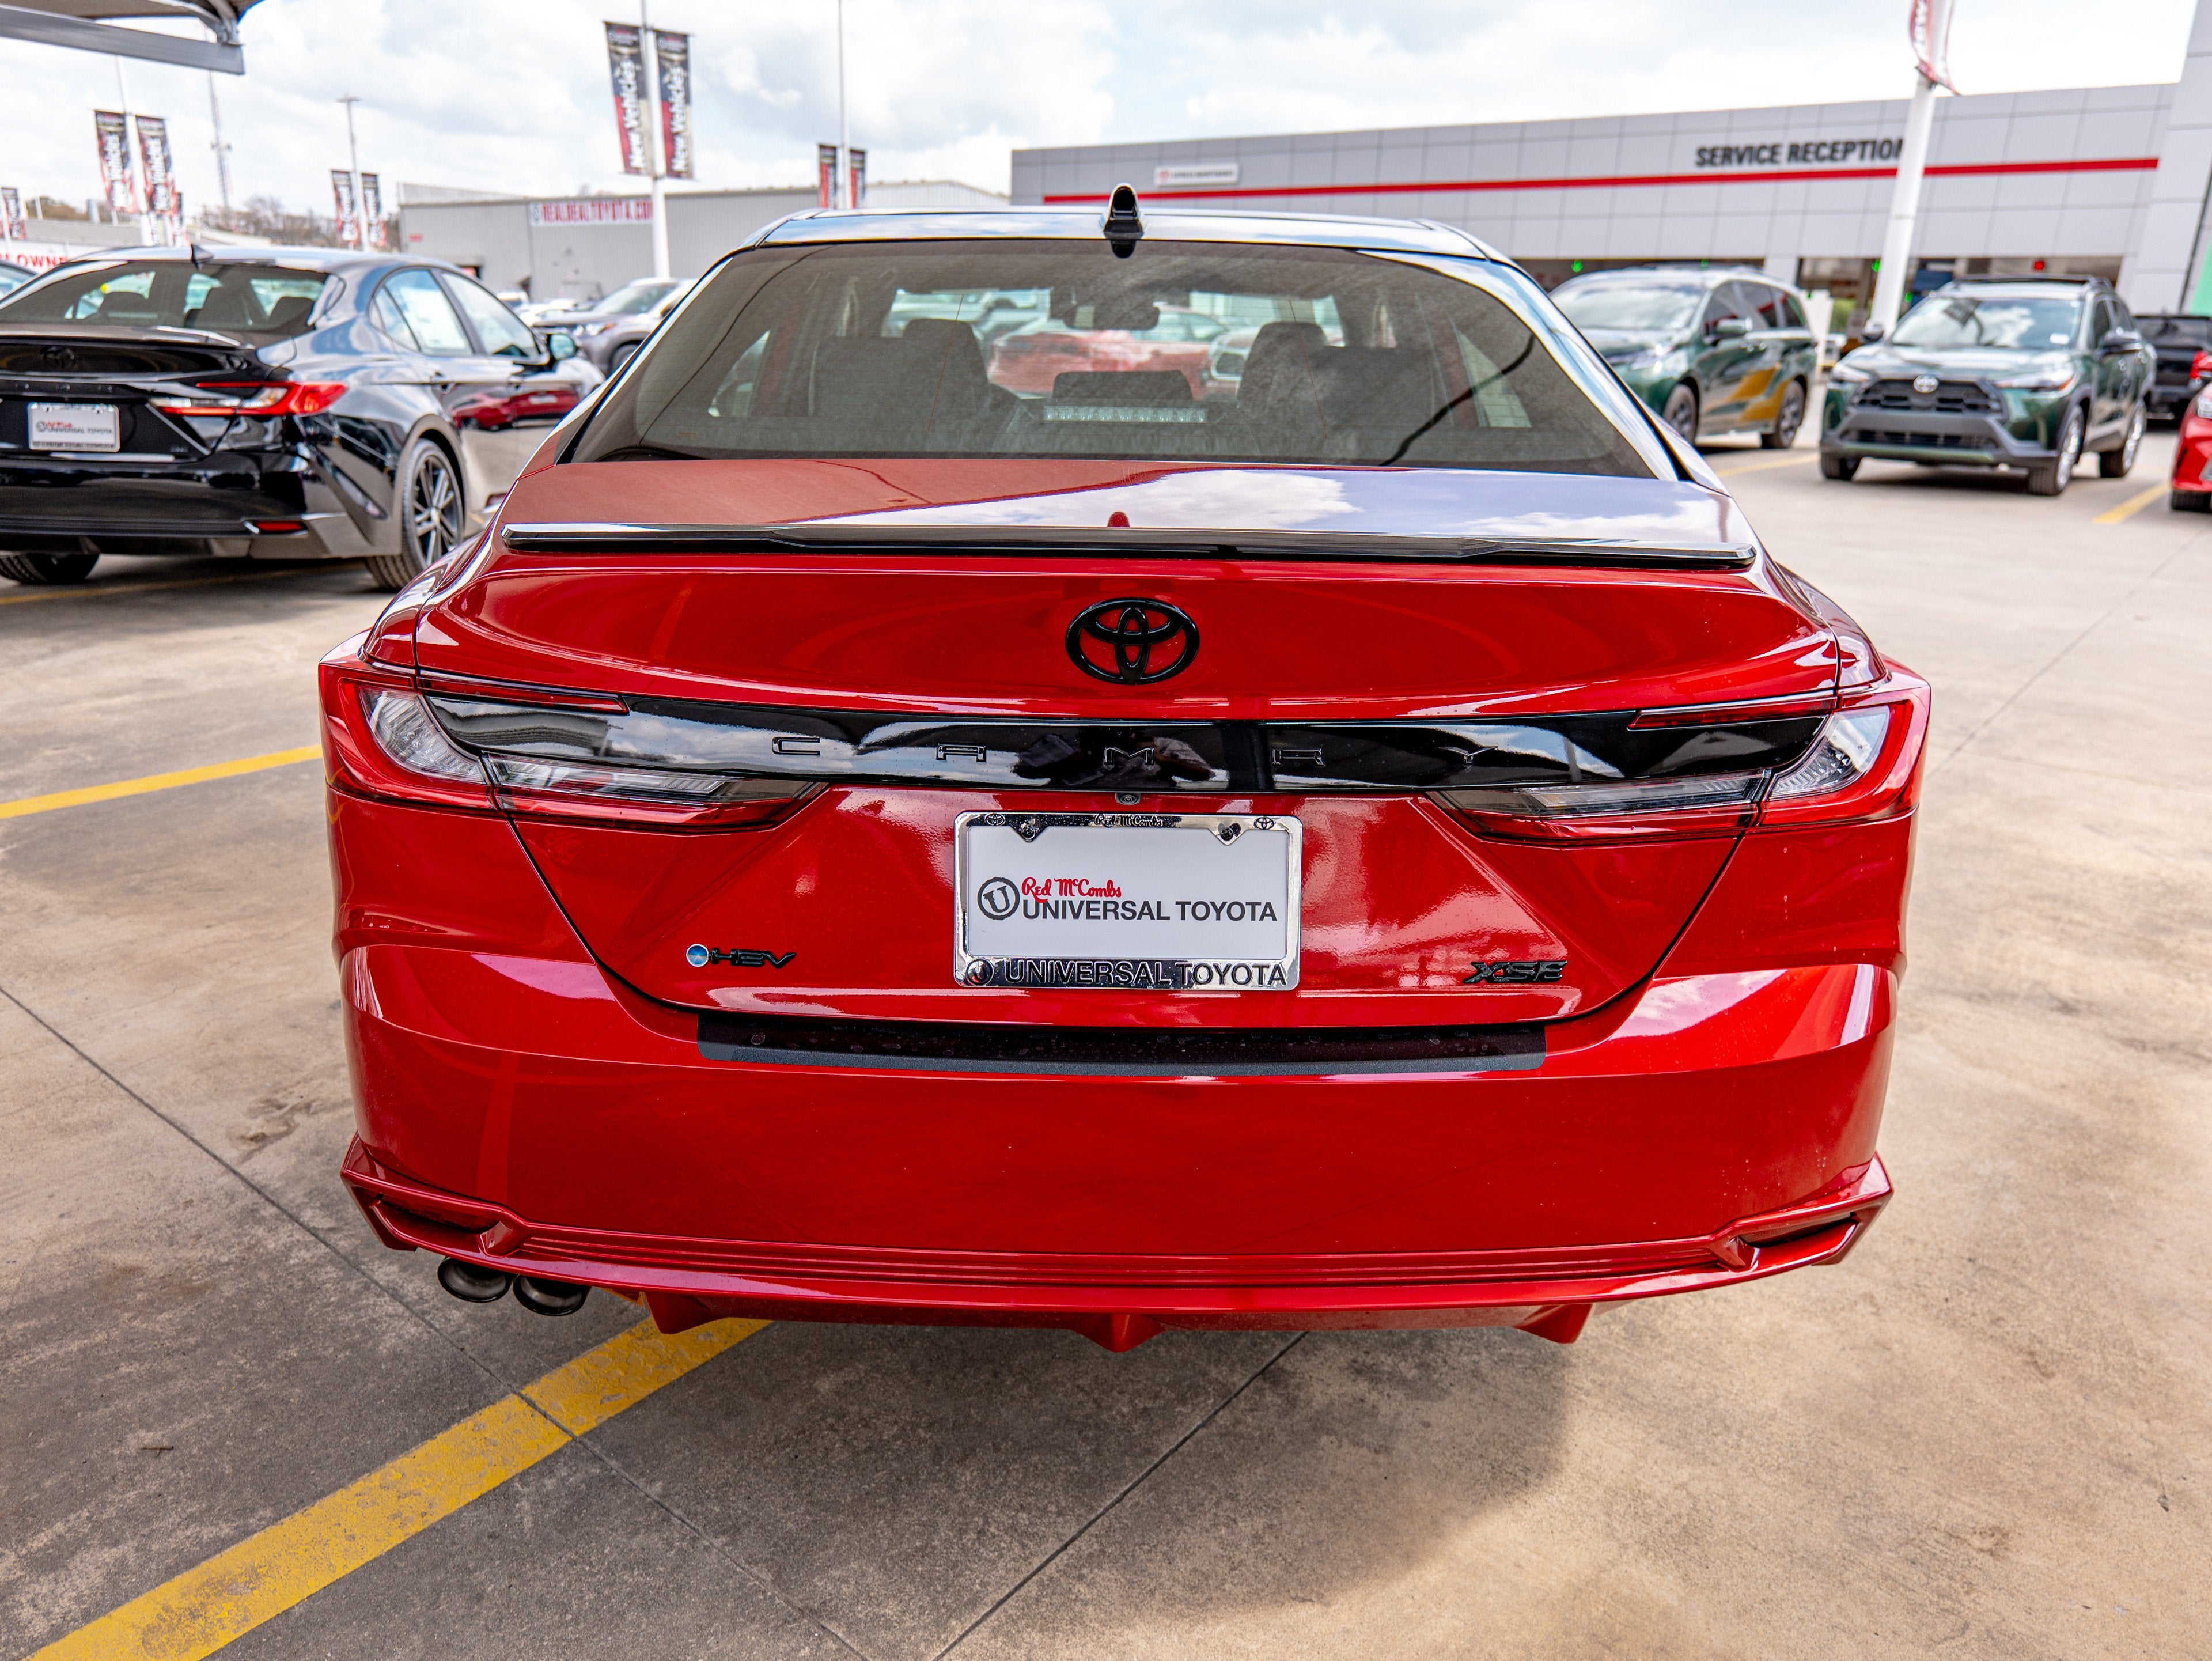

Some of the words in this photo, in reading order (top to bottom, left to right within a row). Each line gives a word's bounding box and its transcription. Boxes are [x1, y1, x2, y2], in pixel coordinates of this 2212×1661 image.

[618, 59, 641, 130] Vehicles
[667, 63, 687, 134] Vehicles
[628, 128, 646, 168] New
[671, 133, 689, 172] New
[1695, 143, 1782, 167] SERVICE
[772, 737, 1498, 763] CAMRY
[1095, 814, 1116, 827] Red
[1120, 814, 1163, 827] McCombs
[1021, 877, 1052, 903] Red
[1054, 878, 1122, 898] McCombs
[1023, 899, 1171, 921] UNIVERSAL
[1175, 901, 1277, 921] TOYOTA
[710, 947, 796, 968] HEV
[1005, 960, 1172, 985] UNIVERSAL
[1175, 962, 1287, 986] TOYOTA
[1462, 960, 1567, 983] XSE
